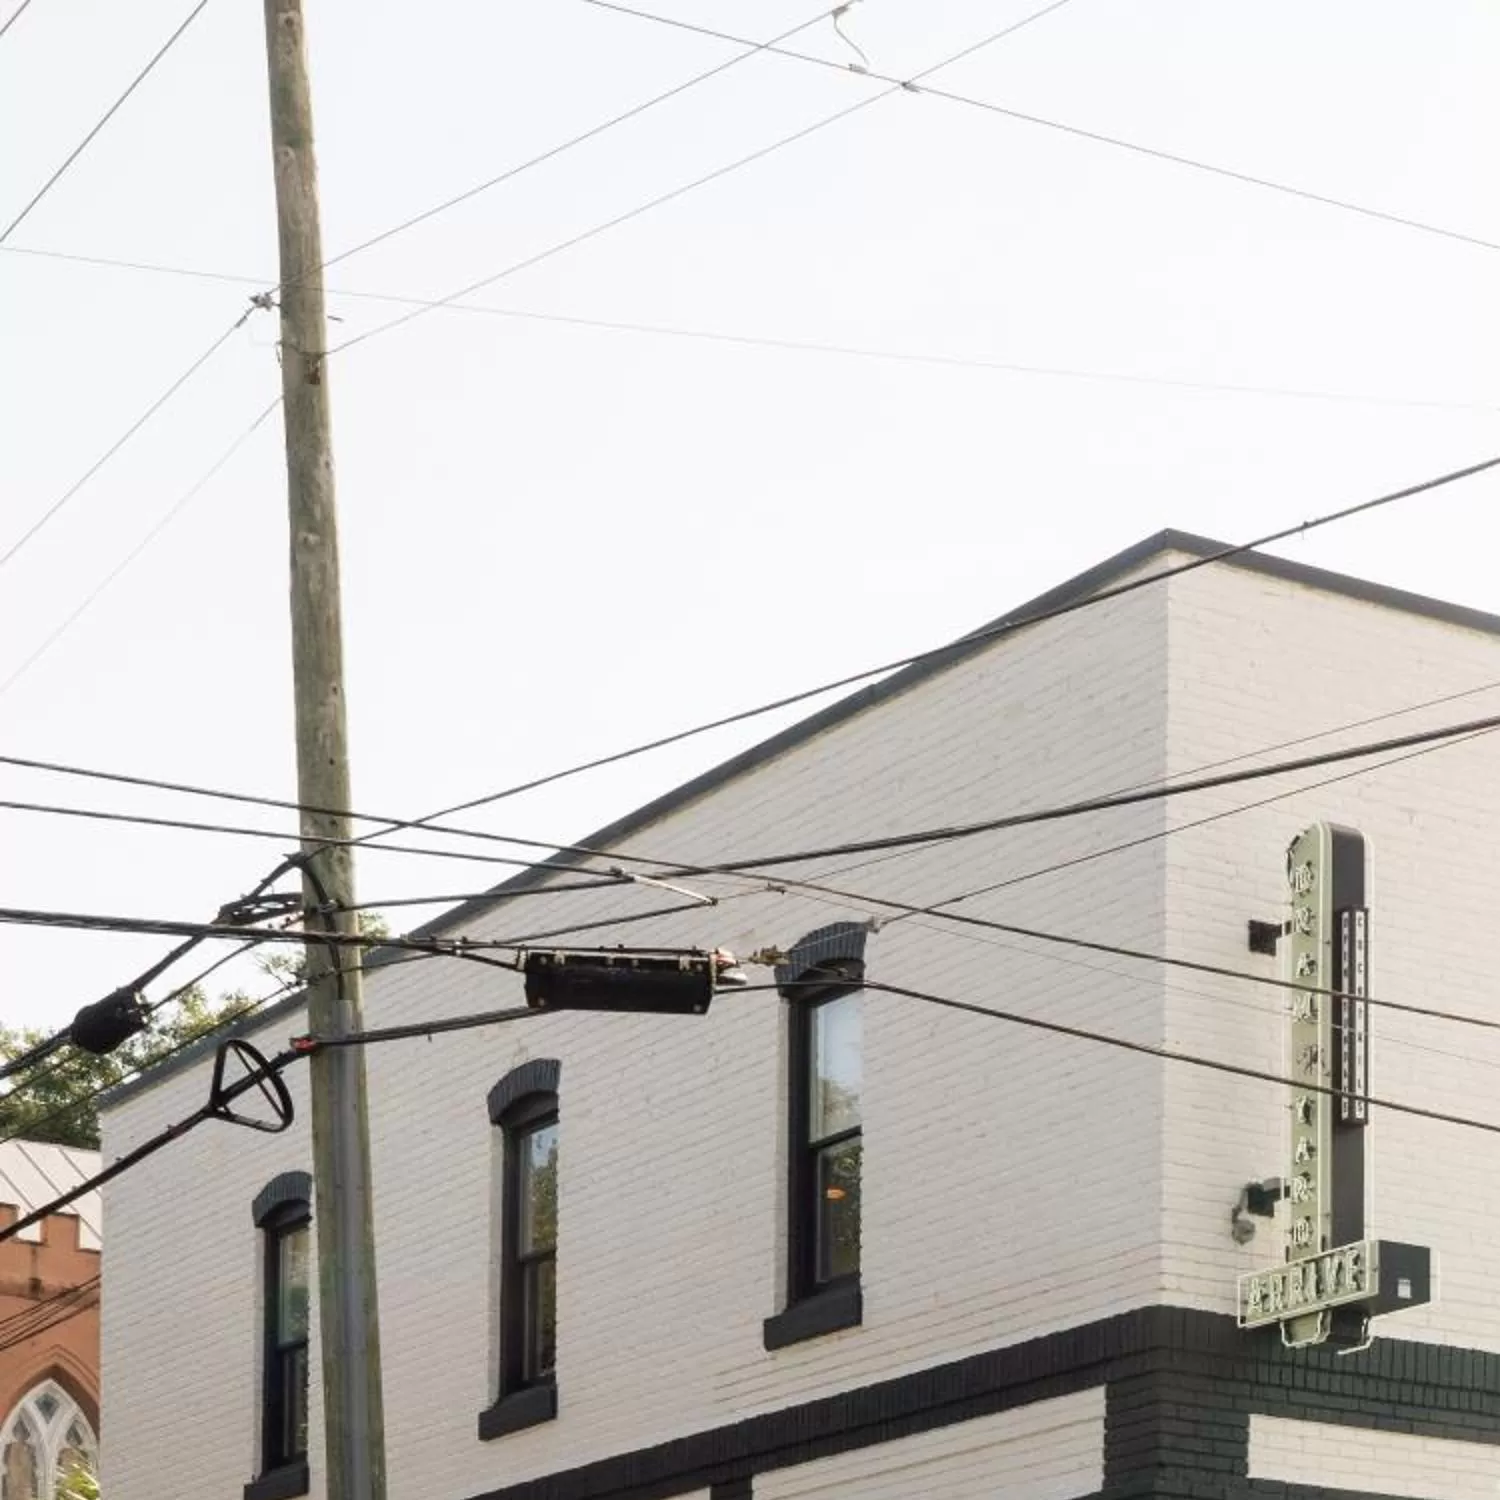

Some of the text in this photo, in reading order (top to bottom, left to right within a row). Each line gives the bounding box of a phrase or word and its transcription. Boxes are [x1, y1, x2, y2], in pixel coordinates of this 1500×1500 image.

[1291, 862, 1317, 1248] DRAM YARD
[1247, 1248, 1365, 1314] ARRIVE
